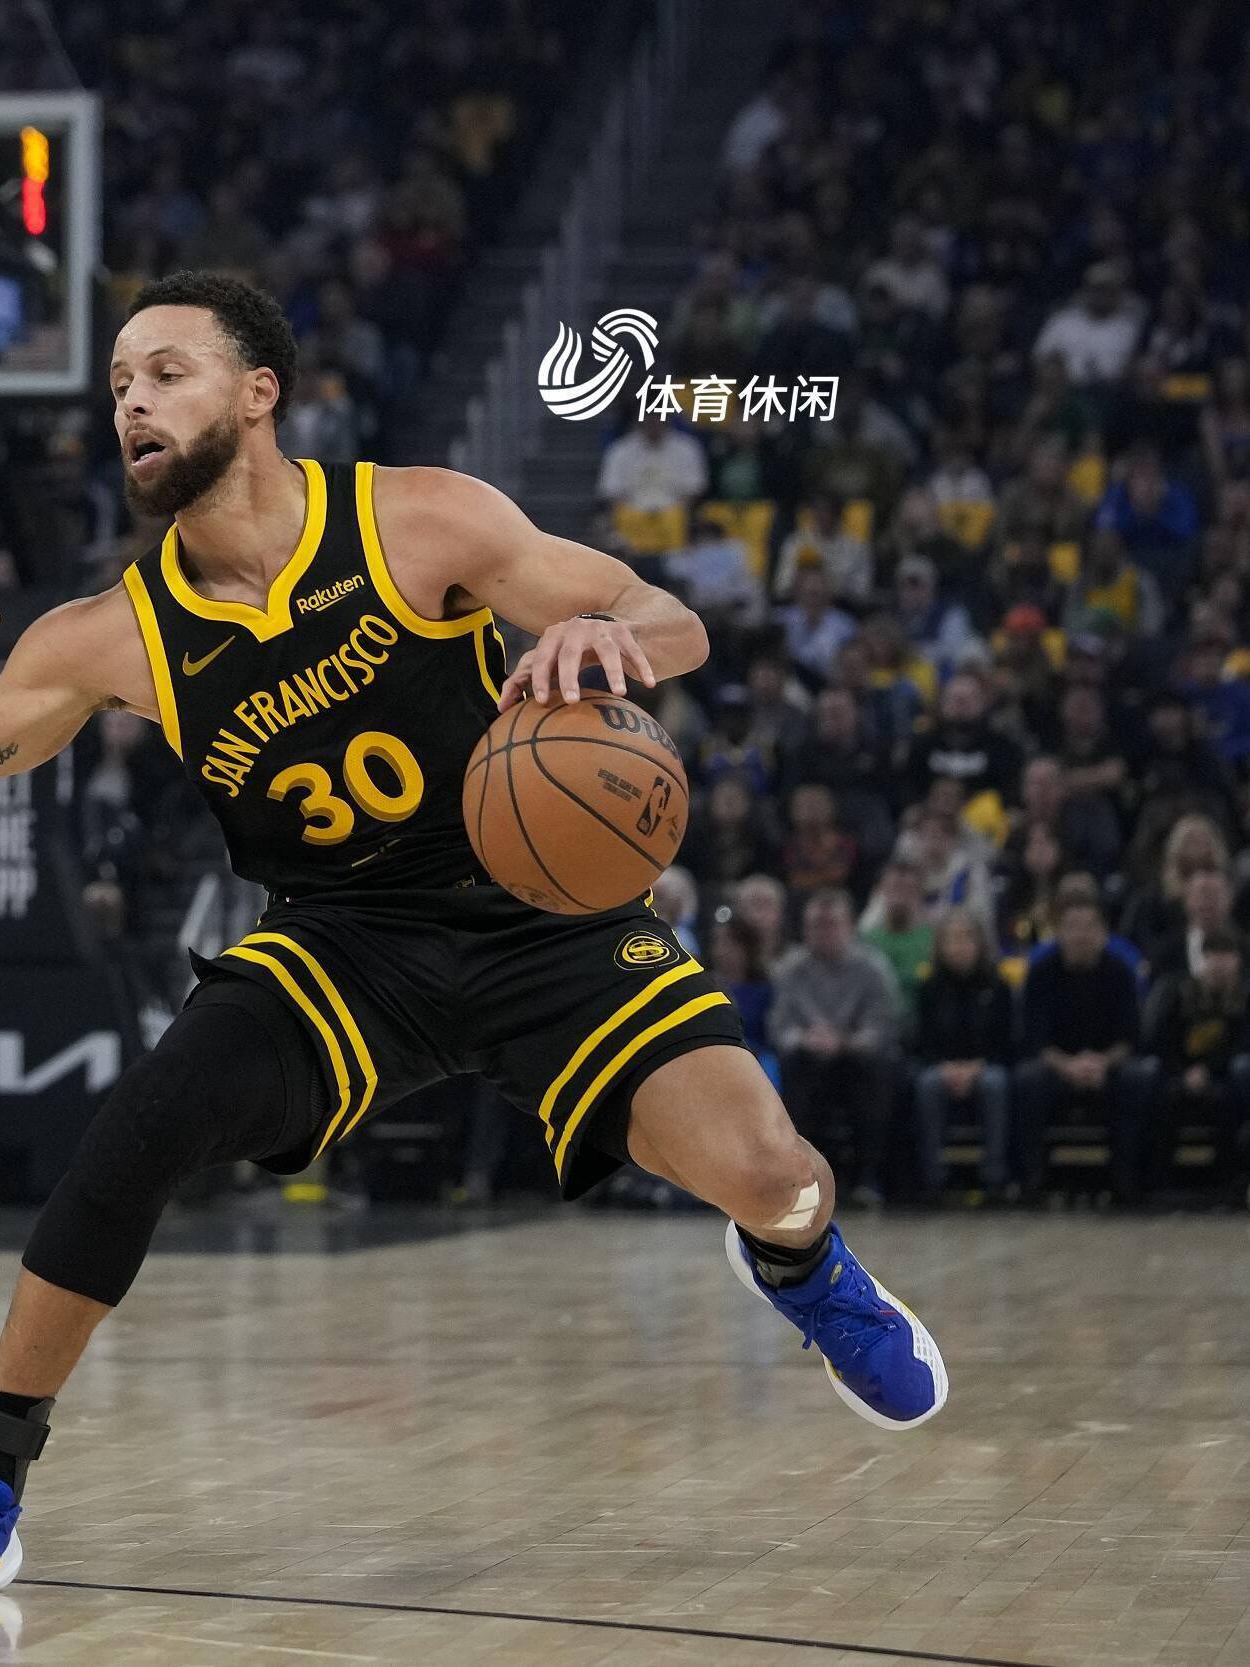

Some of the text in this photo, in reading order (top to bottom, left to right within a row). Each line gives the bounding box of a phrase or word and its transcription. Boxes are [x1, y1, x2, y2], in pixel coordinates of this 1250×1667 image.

[296, 574, 365, 615] Rakuten
[201, 614, 399, 798] SAN FRANCISCO
[267, 731, 424, 846] 30
